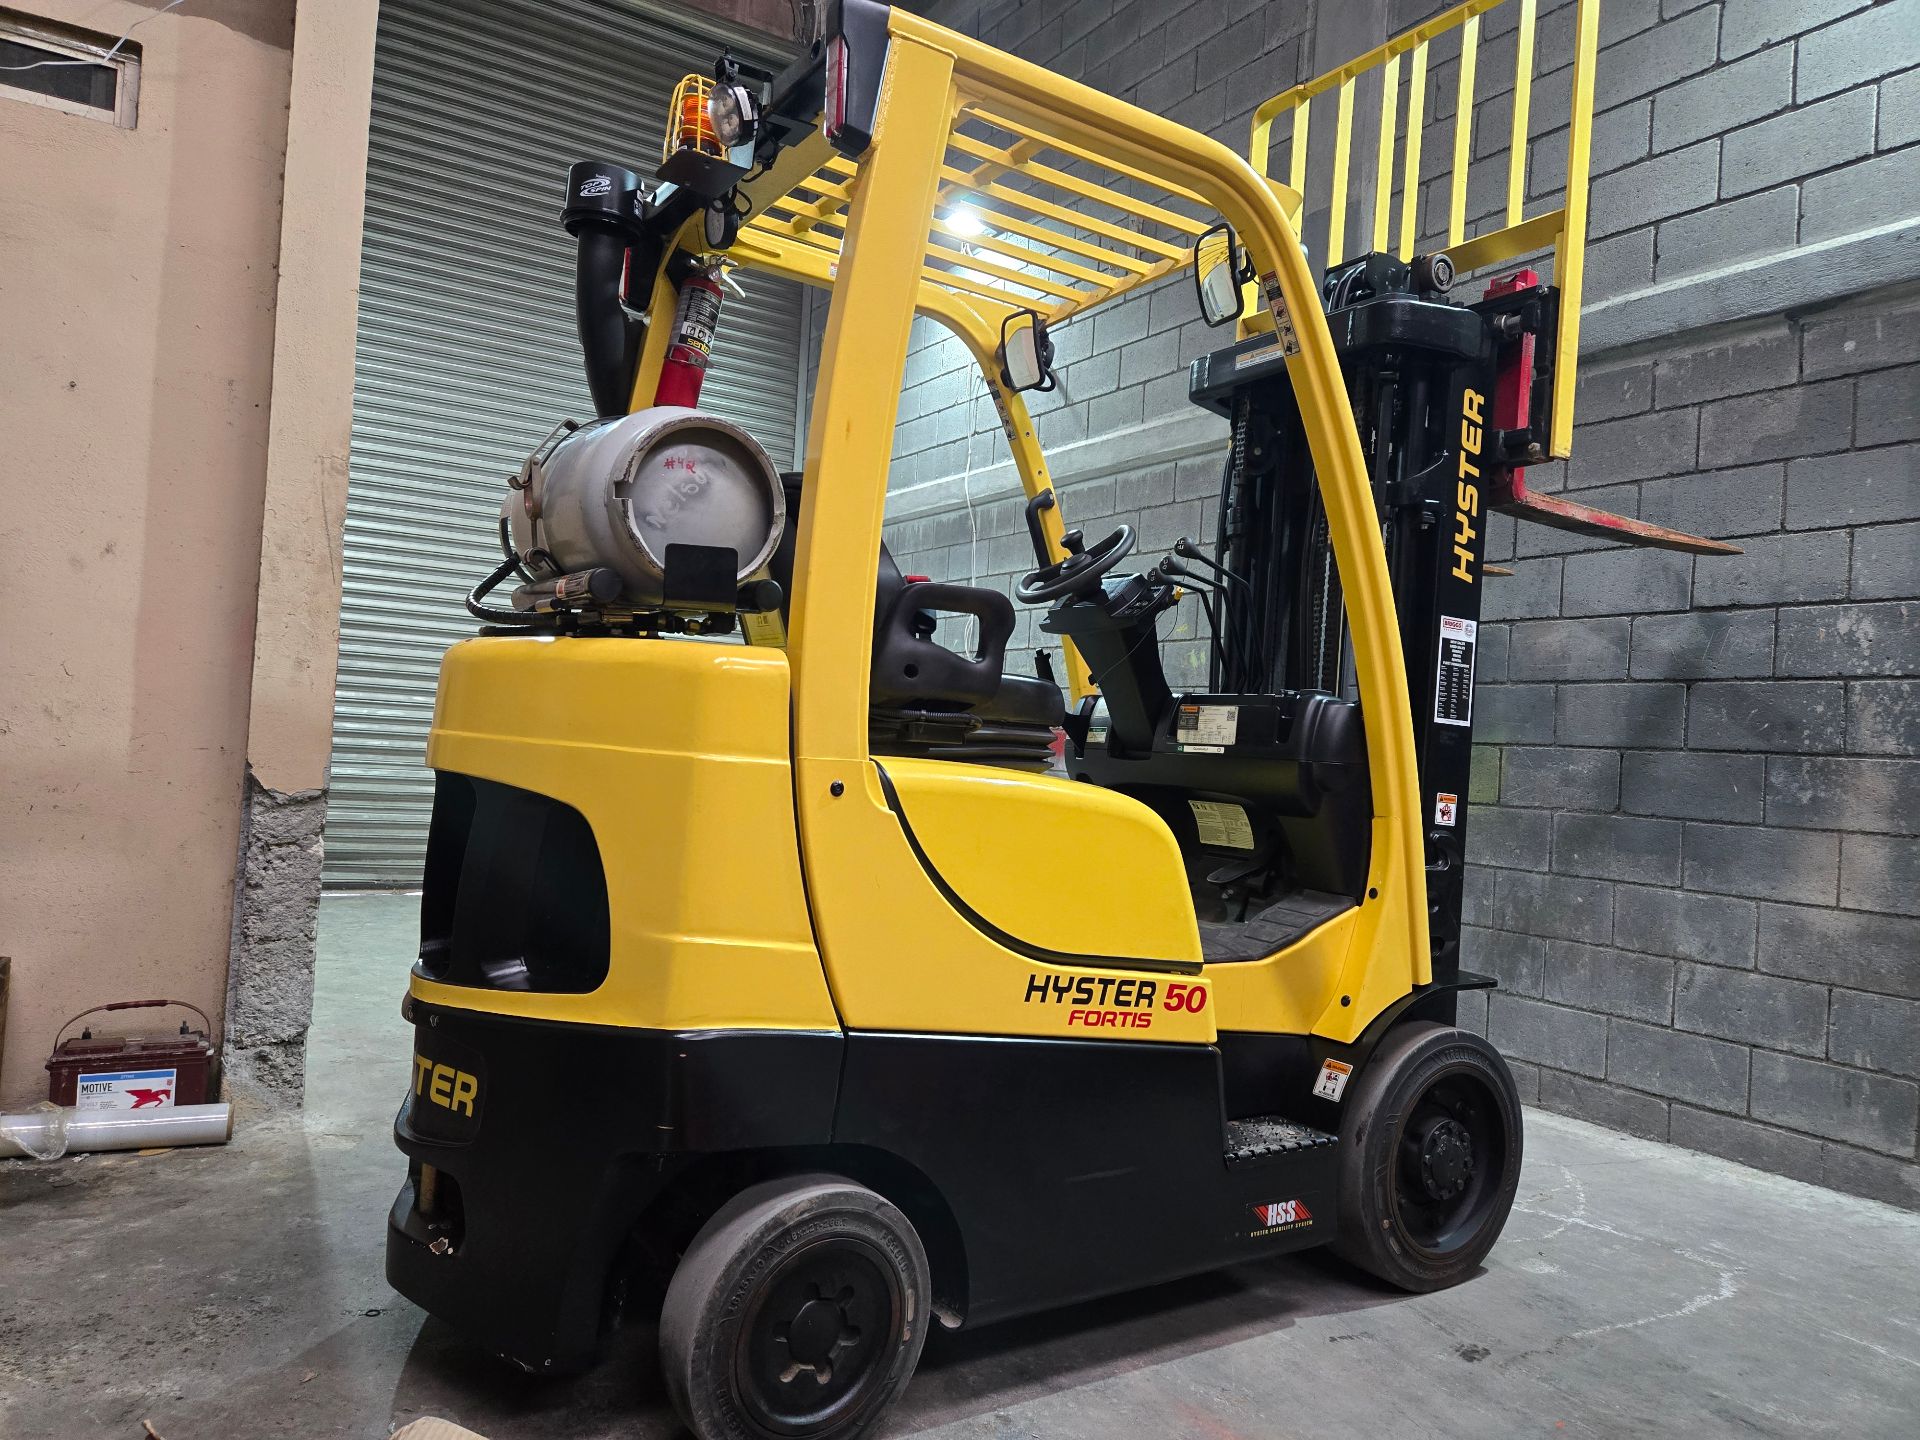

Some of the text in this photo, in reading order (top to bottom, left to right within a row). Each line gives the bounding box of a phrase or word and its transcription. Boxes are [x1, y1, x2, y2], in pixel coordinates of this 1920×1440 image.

[580, 181, 600, 191] TOP
[1452, 388, 1485, 584] HYSTER
[1024, 974, 1207, 1013] HYSTER 50
[1068, 1009, 1153, 1028] FORTIS
[81, 1083, 113, 1094] MOTIVE
[416, 1053, 478, 1118] TER
[1267, 1200, 1296, 1226] HSS
